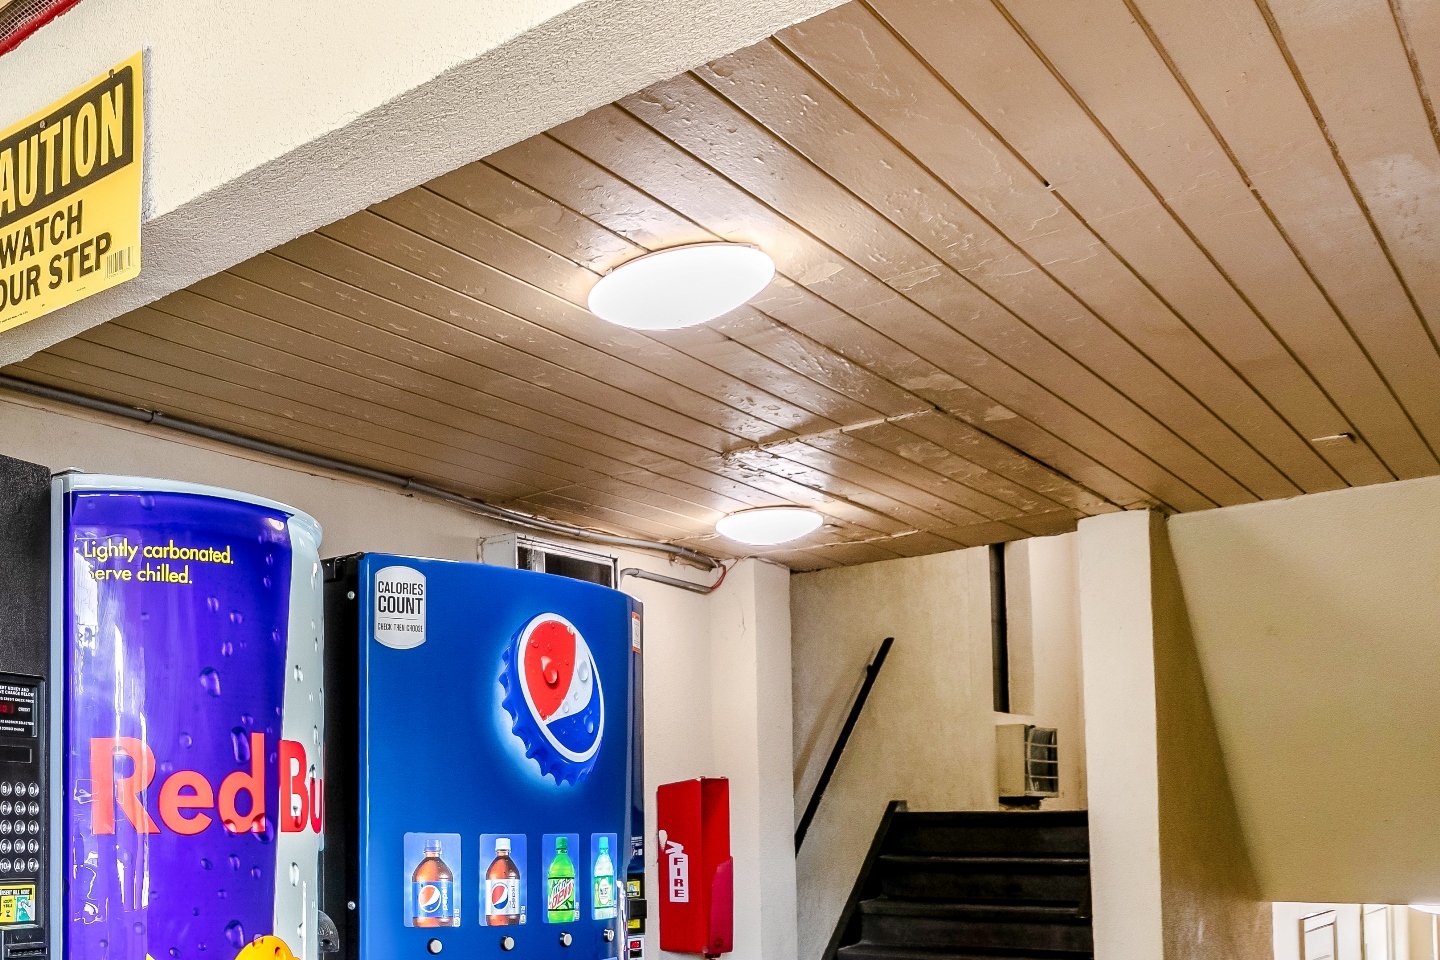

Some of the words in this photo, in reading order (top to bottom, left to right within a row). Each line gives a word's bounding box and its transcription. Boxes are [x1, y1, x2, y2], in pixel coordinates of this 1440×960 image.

[48, 232, 112, 290] STEP
[84, 538, 138, 563] Lightly
[143, 540, 234, 564] carbonated.
[136, 563, 193, 584] chilled.
[378, 581, 424, 596] CALORIES
[378, 596, 423, 614] COUNT
[378, 622, 392, 631] CHECK
[90, 732, 265, 836] Red
[278, 739, 323, 834] Bu
[673, 857, 685, 898] FIRE
